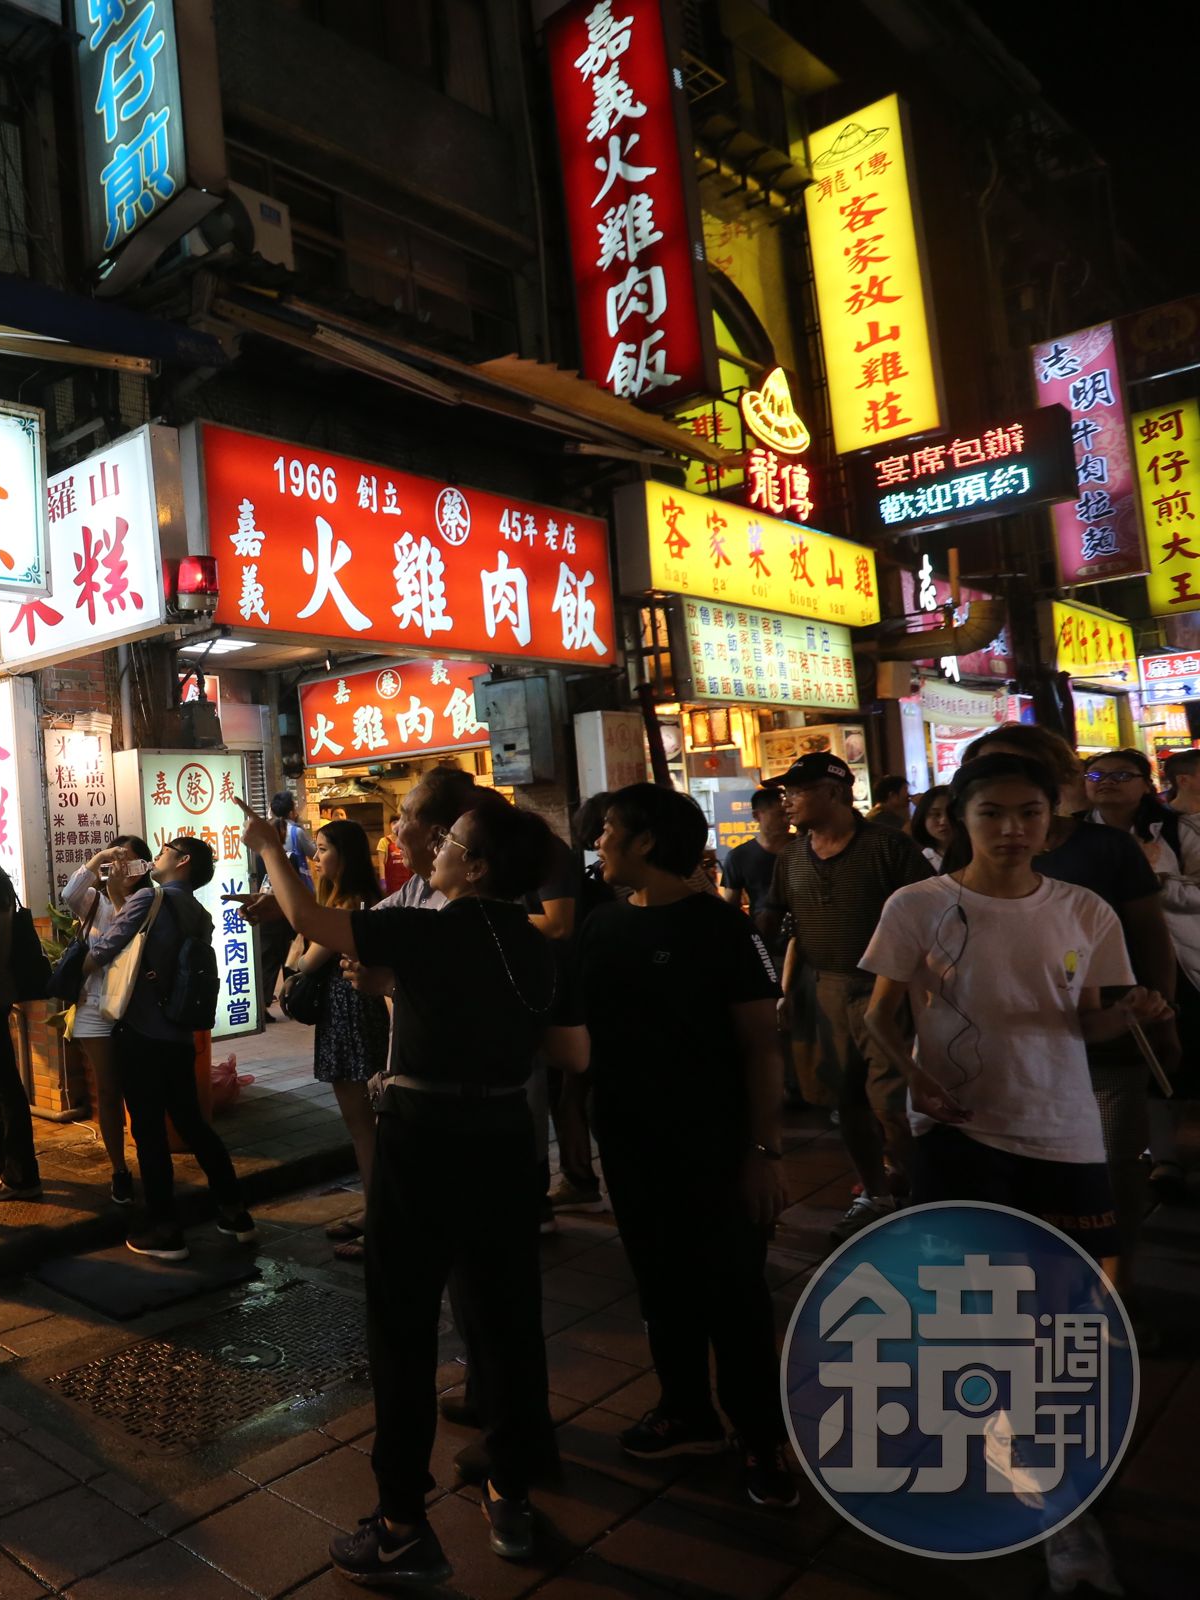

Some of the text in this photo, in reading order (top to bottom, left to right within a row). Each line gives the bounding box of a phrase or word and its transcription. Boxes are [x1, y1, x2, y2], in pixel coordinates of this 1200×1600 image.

[574, 0, 681, 399] 嘉義火雞肉飯
[839, 192, 913, 434] 客家放山雞莊
[875, 423, 1025, 487] 宴席包辦
[1040, 341, 1119, 561] 志明牛肉拉麵
[273, 456, 401, 516] 1966 創立
[879, 464, 1031, 524] 歡迎預約
[1139, 409, 1200, 605] 蚵仔煎大王
[229, 498, 270, 625] 嘉義
[297, 515, 608, 657] 火雞肉飯
[332, 679, 351, 705] 嘉
[430, 660, 452, 685] 義
[310, 687, 490, 757] 火雞肉飯
[58, 791, 106, 807] 30 70
[103, 814, 114, 826] 40
[151, 771, 172, 805] 嘉
[219, 772, 237, 804] 義
[54, 831, 101, 846] 排骨酥湯
